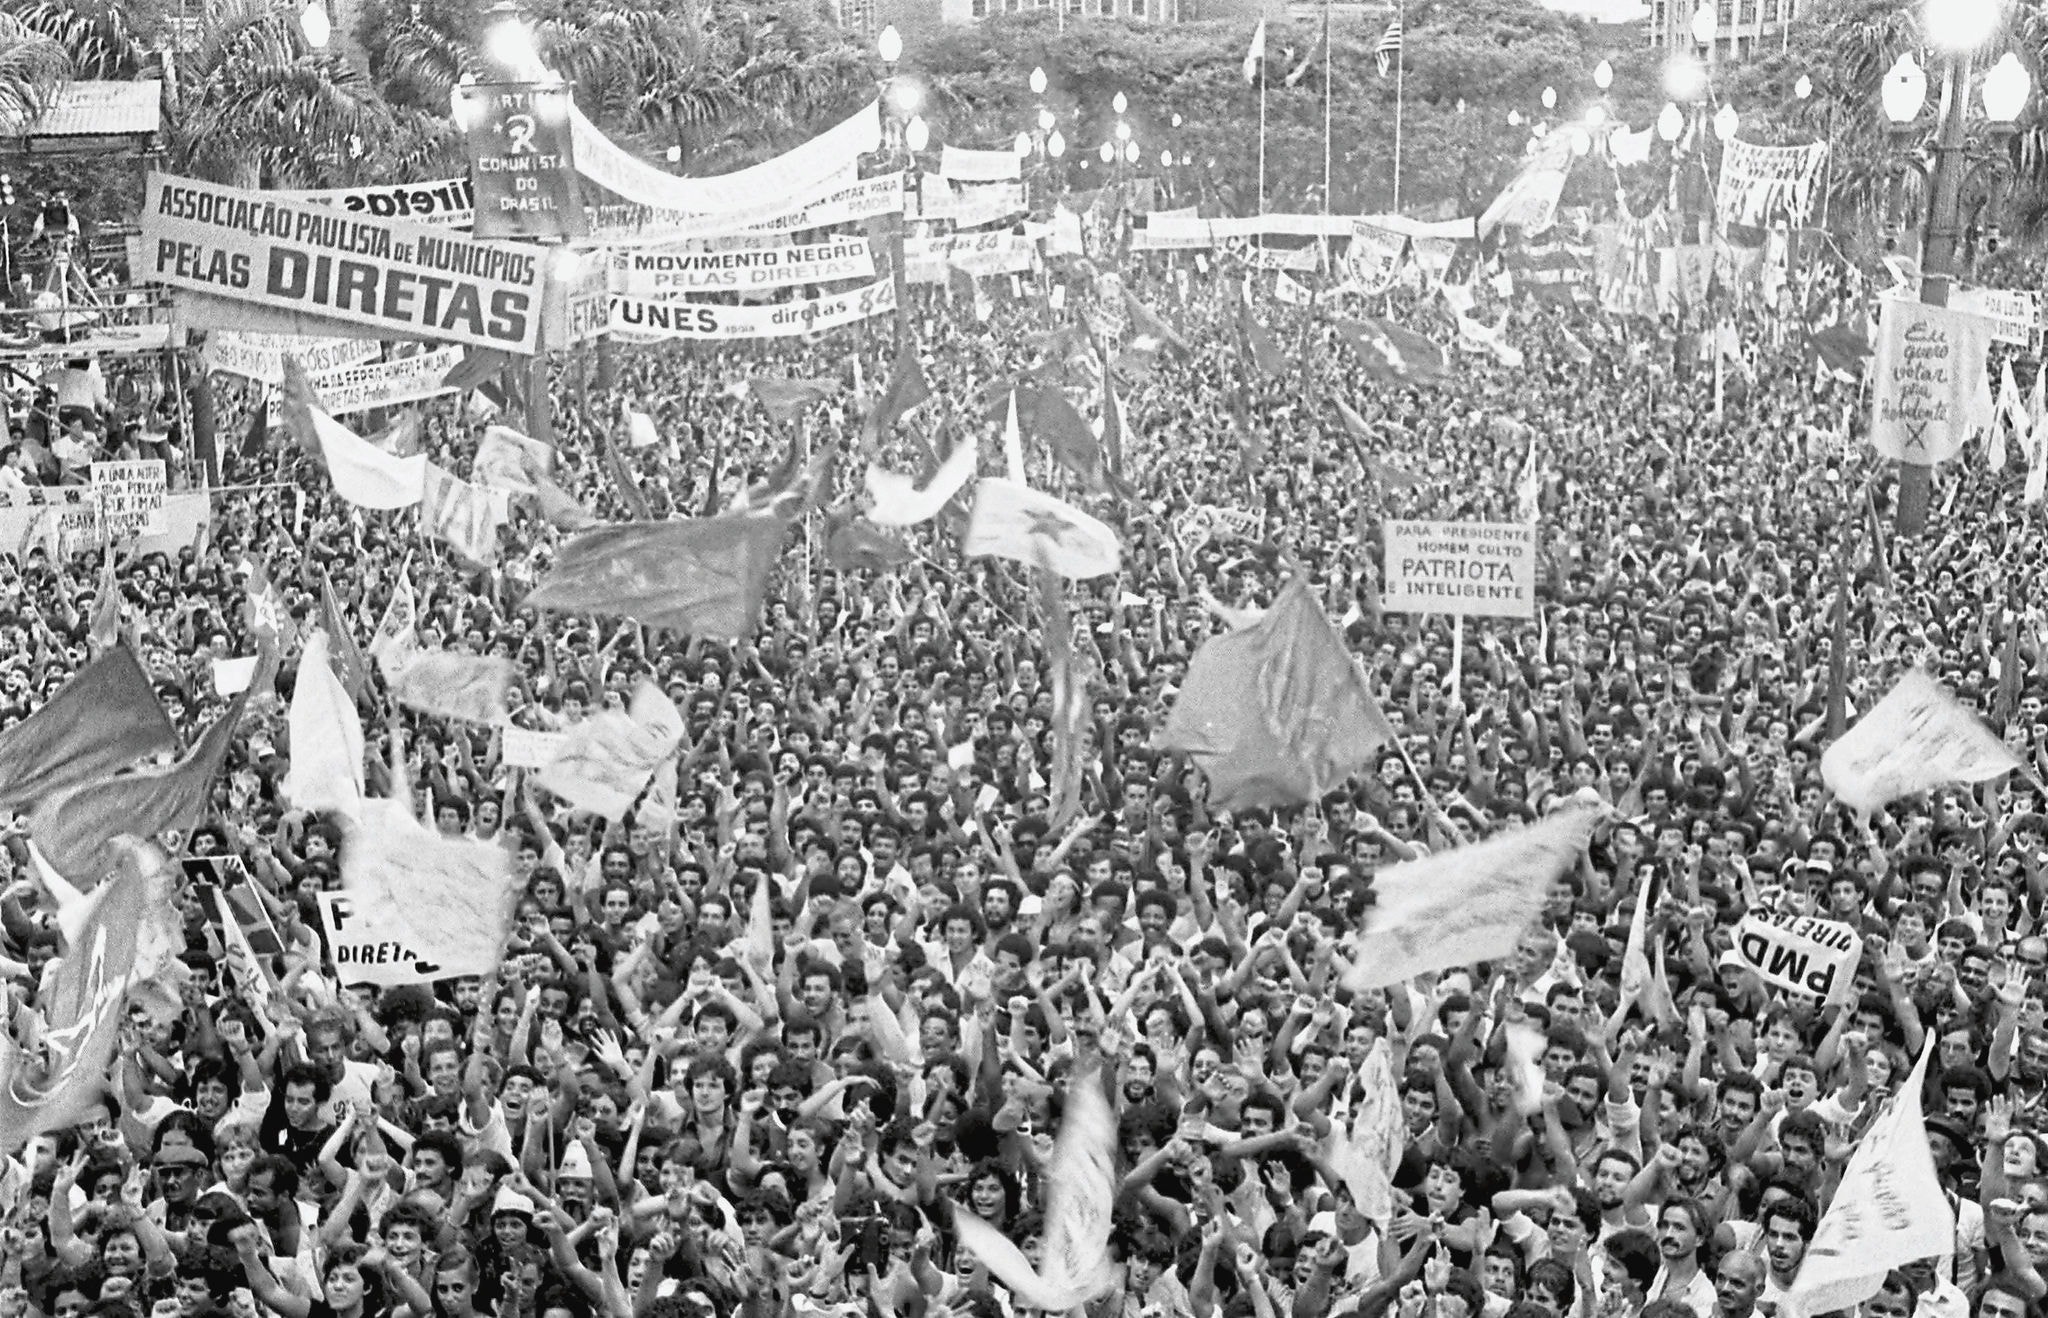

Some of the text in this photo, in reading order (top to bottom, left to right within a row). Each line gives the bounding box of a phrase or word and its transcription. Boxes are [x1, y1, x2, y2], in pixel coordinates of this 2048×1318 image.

[478, 156, 568, 172] COMUNISTA
[515, 177, 538, 191] DO
[159, 184, 536, 287] ASSOCIAÇÃO PAULISTA DE MUNICÍPIOS
[635, 243, 864, 271] MOVIMENTO NEGRO
[654, 261, 856, 287] PELAS DIRETAS
[157, 238, 529, 343] PELAS DIRETAS
[1396, 525, 1531, 543] PARA PRESIDENTE
[1417, 541, 1523, 558] HOMEM CULTO
[1402, 557, 1515, 583] PATRIOTA
[1407, 581, 1524, 600] INTELIGENTE
